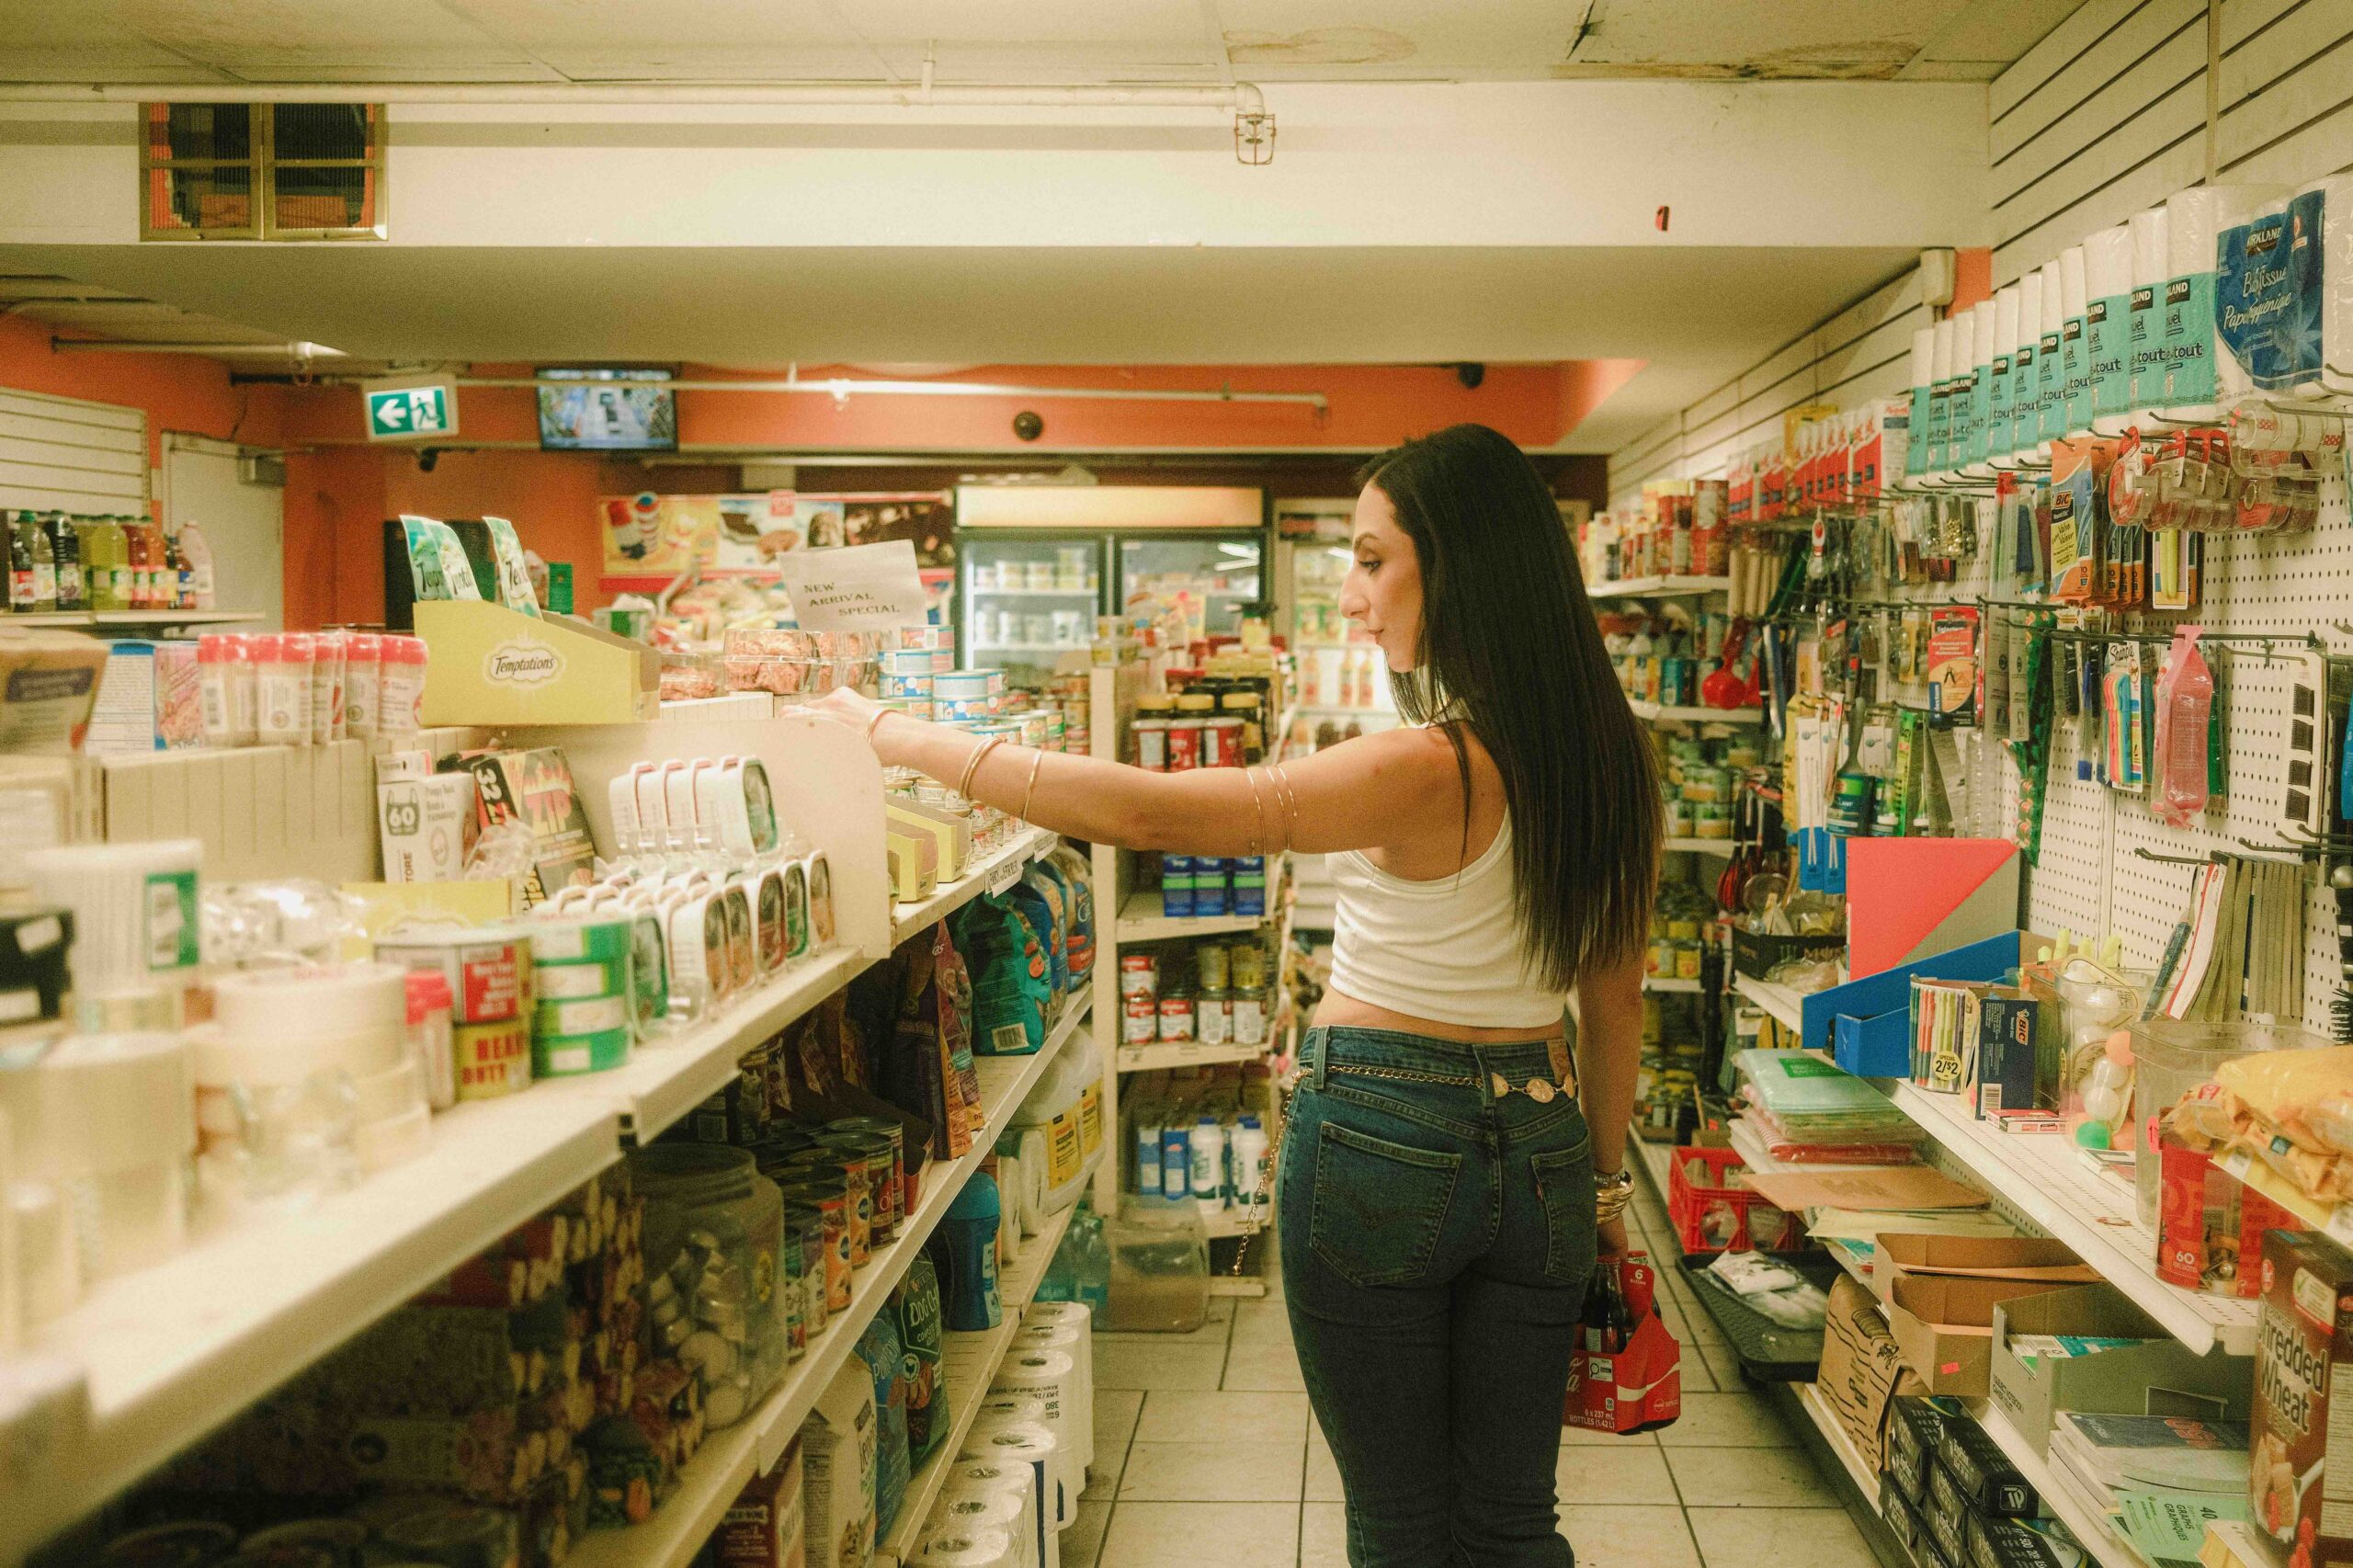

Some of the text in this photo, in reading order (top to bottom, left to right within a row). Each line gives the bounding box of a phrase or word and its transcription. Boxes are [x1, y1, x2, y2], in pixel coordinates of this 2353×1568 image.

[2056, 494, 2070, 506] BIC
[803, 581, 835, 593] NEW
[810, 593, 875, 608] ARRIVAL
[838, 604, 901, 617] SPECIAL
[494, 655, 554, 676] Temptations
[475, 767, 503, 801] 32
[388, 808, 416, 826] 60
[2018, 1018, 2027, 1041] BIC
[1935, 1061, 1959, 1075] 2/$2
[2176, 1250, 2195, 1265] 60
[1635, 1269, 1643, 1280] 6
[2260, 1354, 2310, 1435] Wheat
[1045, 1400, 1059, 1410] 380
[1569, 1415, 1595, 1426] BOTTLES
[1594, 1410, 1604, 1418] 237
[1605, 1412, 1615, 1420] mL
[2177, 1504, 2194, 1529] GRAPHS
[2200, 1506, 2219, 1519] 40
[2164, 1503, 2188, 1542] GRAPHIQUES
